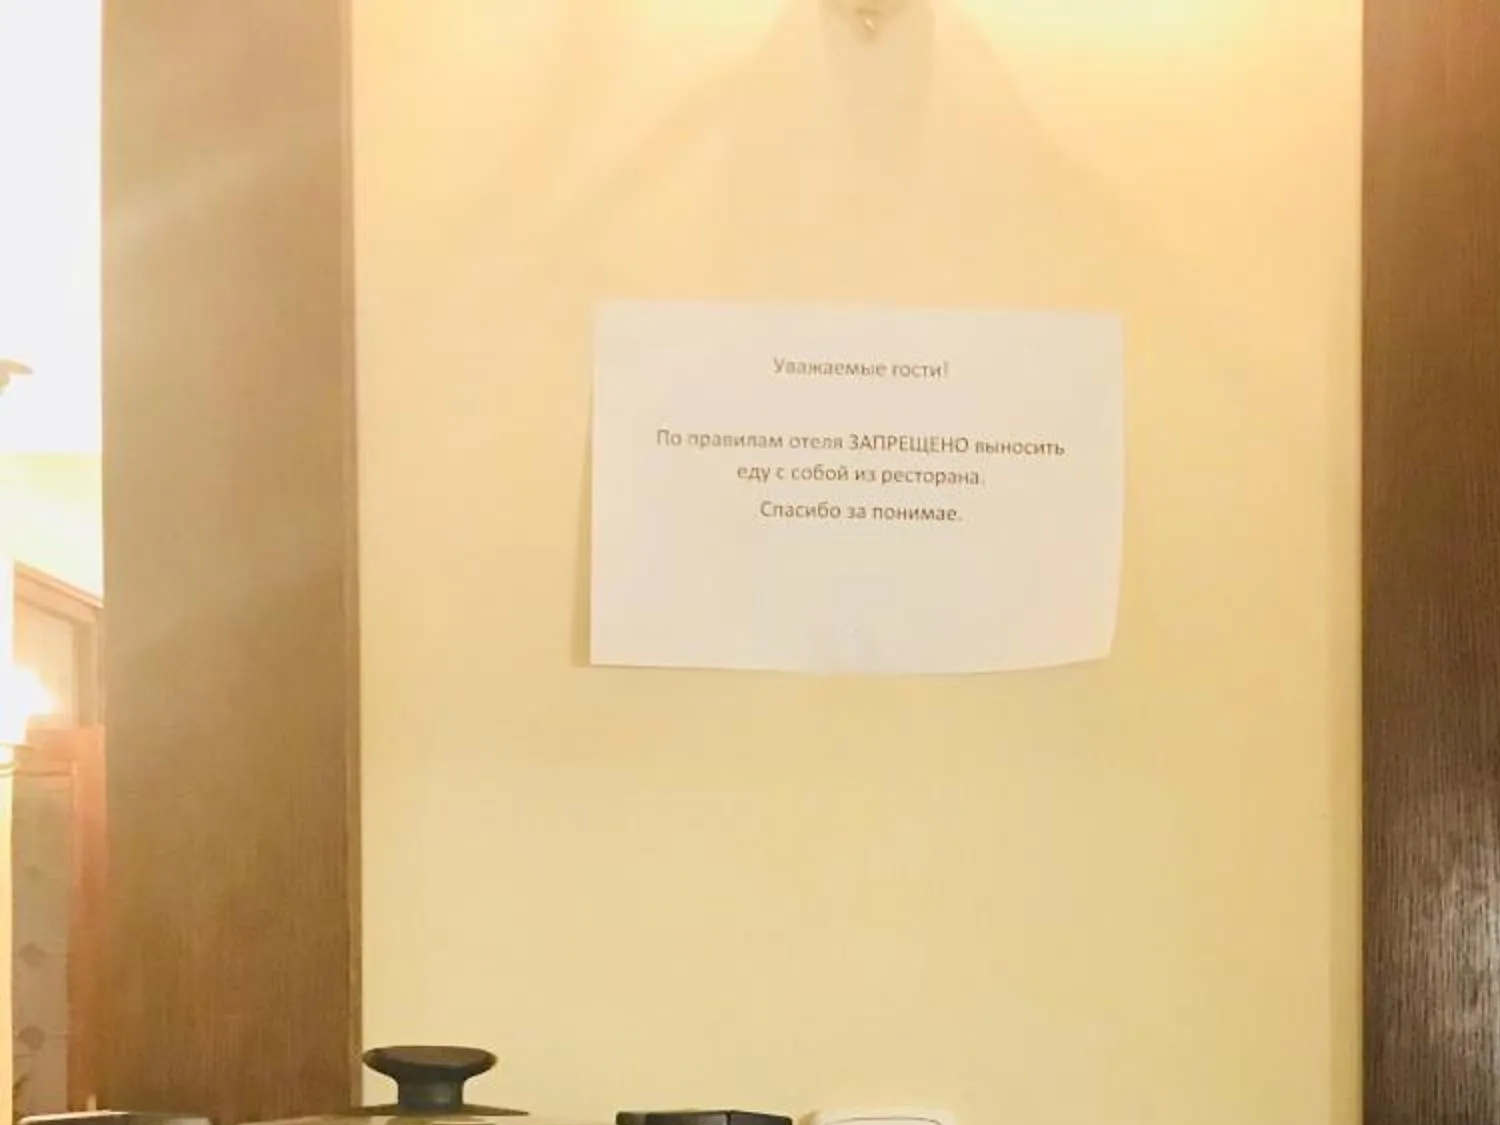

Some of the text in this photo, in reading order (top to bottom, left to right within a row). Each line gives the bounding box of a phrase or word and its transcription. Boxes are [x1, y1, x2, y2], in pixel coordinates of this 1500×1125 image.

[772, 356, 949, 378] Уважаемые гости!
[656, 428, 1065, 456] По правилам отеля ЗАПРЕЩЕНО выносить
[737, 465, 770, 483] еду
[776, 466, 785, 479] с
[791, 463, 849, 481] собой
[855, 468, 876, 482] из
[760, 500, 841, 519] Спасибо
[847, 505, 867, 519] за
